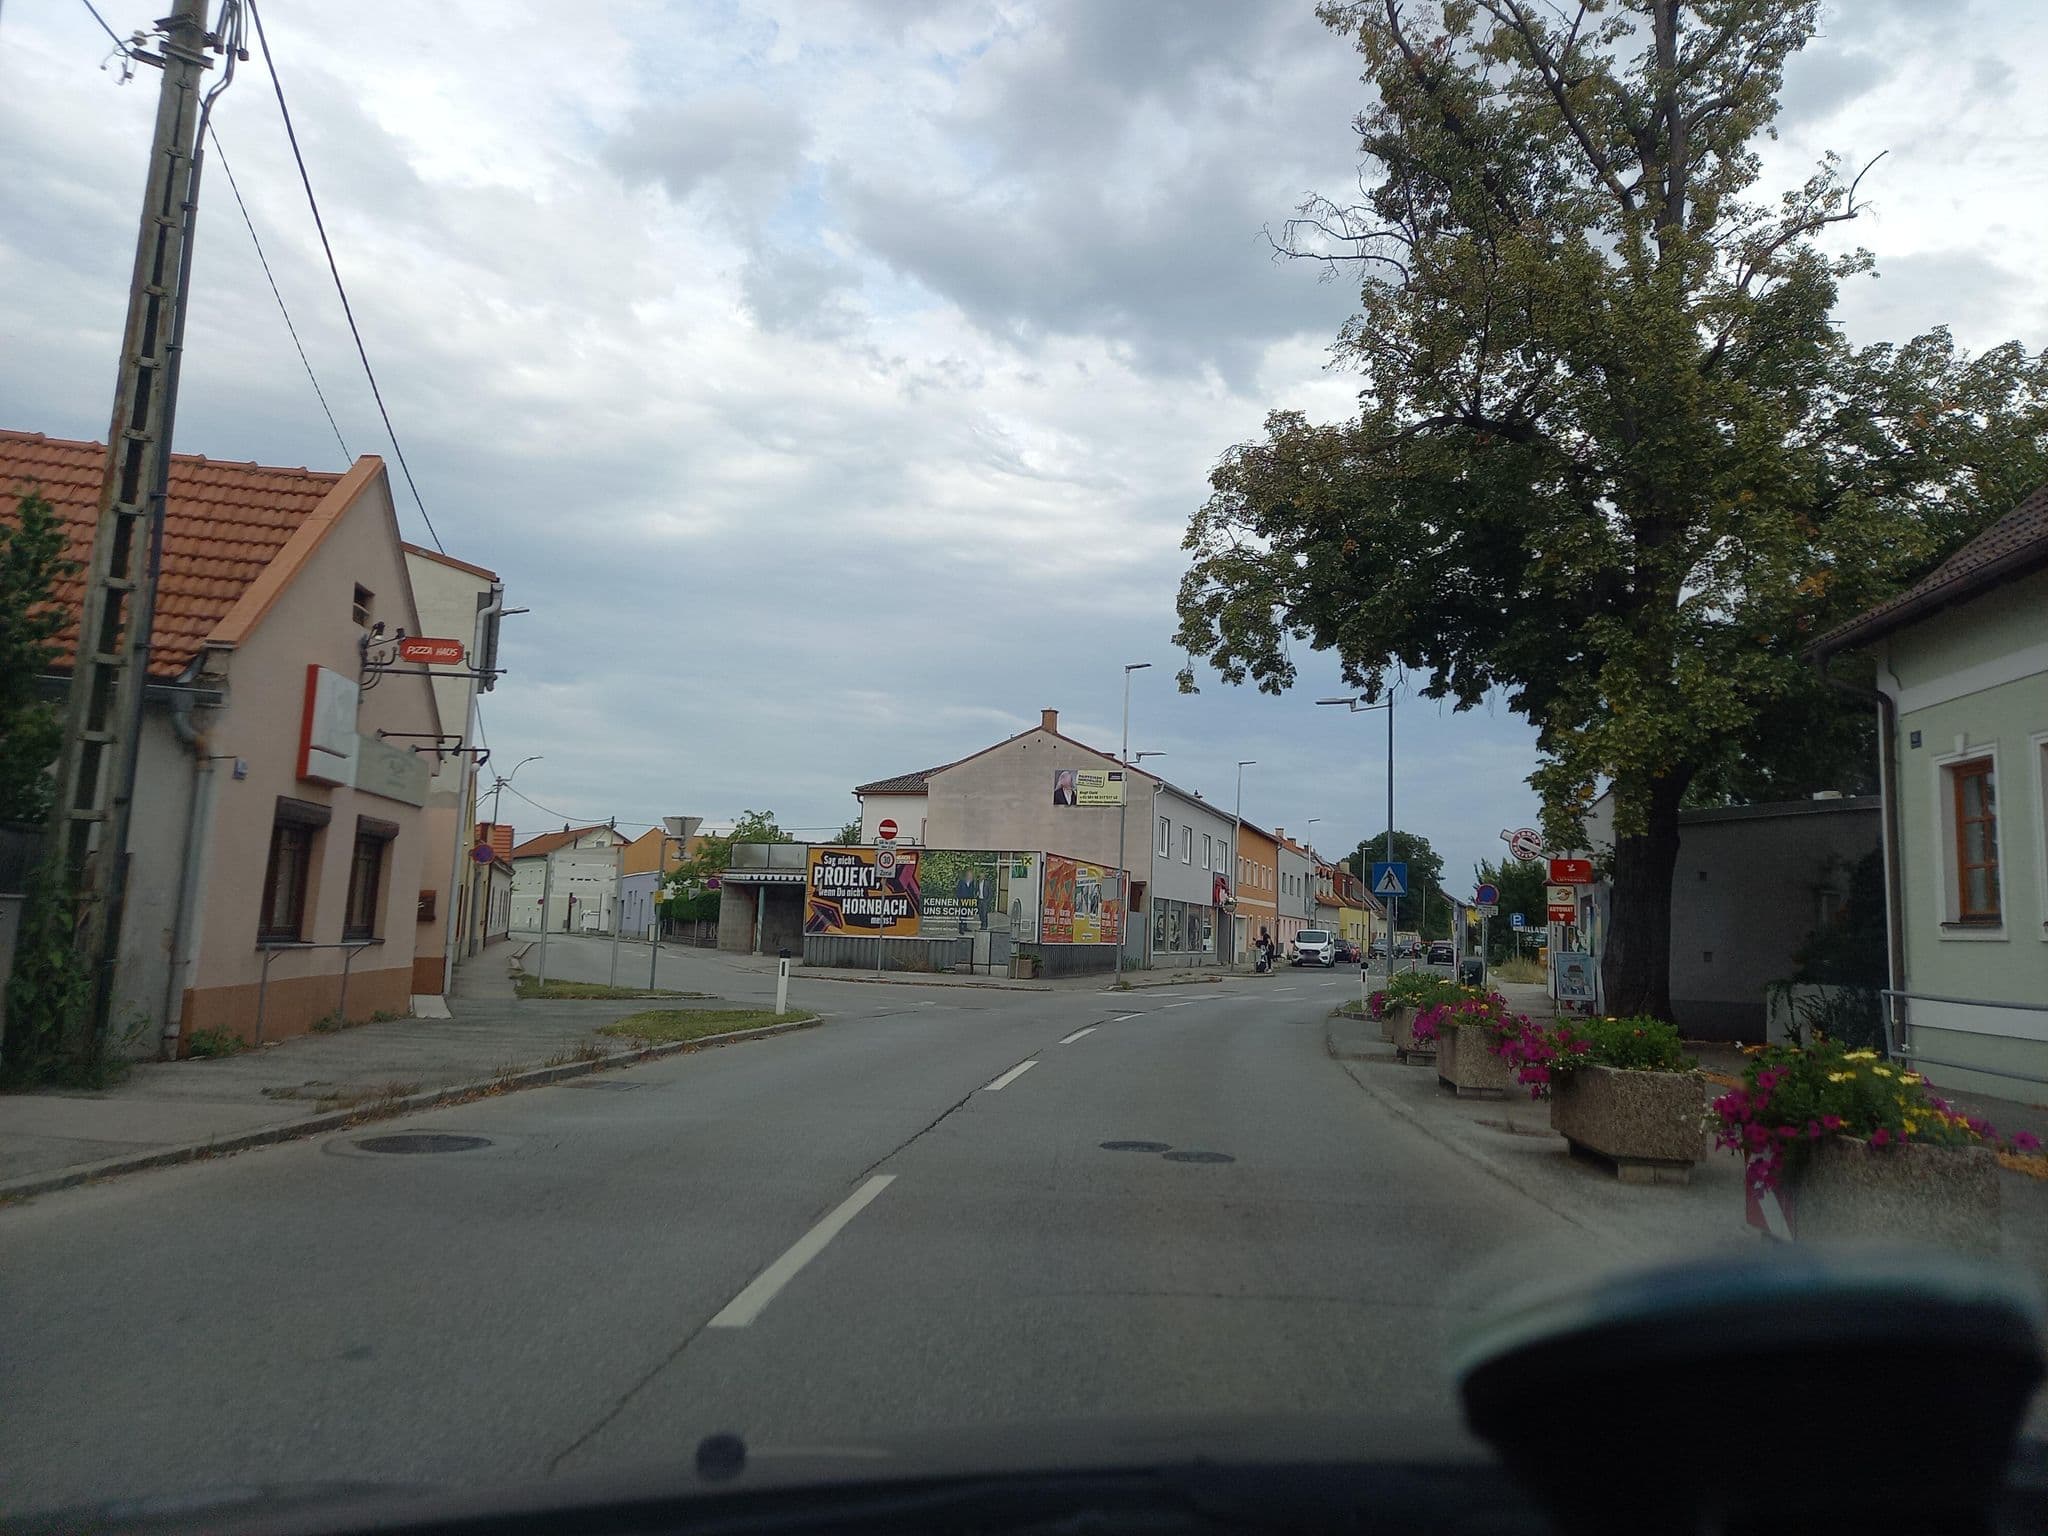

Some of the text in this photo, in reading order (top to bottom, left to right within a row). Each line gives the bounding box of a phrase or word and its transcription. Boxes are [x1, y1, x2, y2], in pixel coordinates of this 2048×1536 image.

[406, 645, 433, 655] PIZZA
[823, 855, 856, 867] Sag nicht
[813, 865, 881, 889] PROJEKT,
[836, 887, 846, 897] Du
[846, 887, 865, 897] nicht
[842, 898, 907, 916] HORNBACH
[923, 897, 978, 907] KENNEN WIR
[923, 907, 979, 916] UNS SCHON?
[870, 916, 896, 925] menst.
